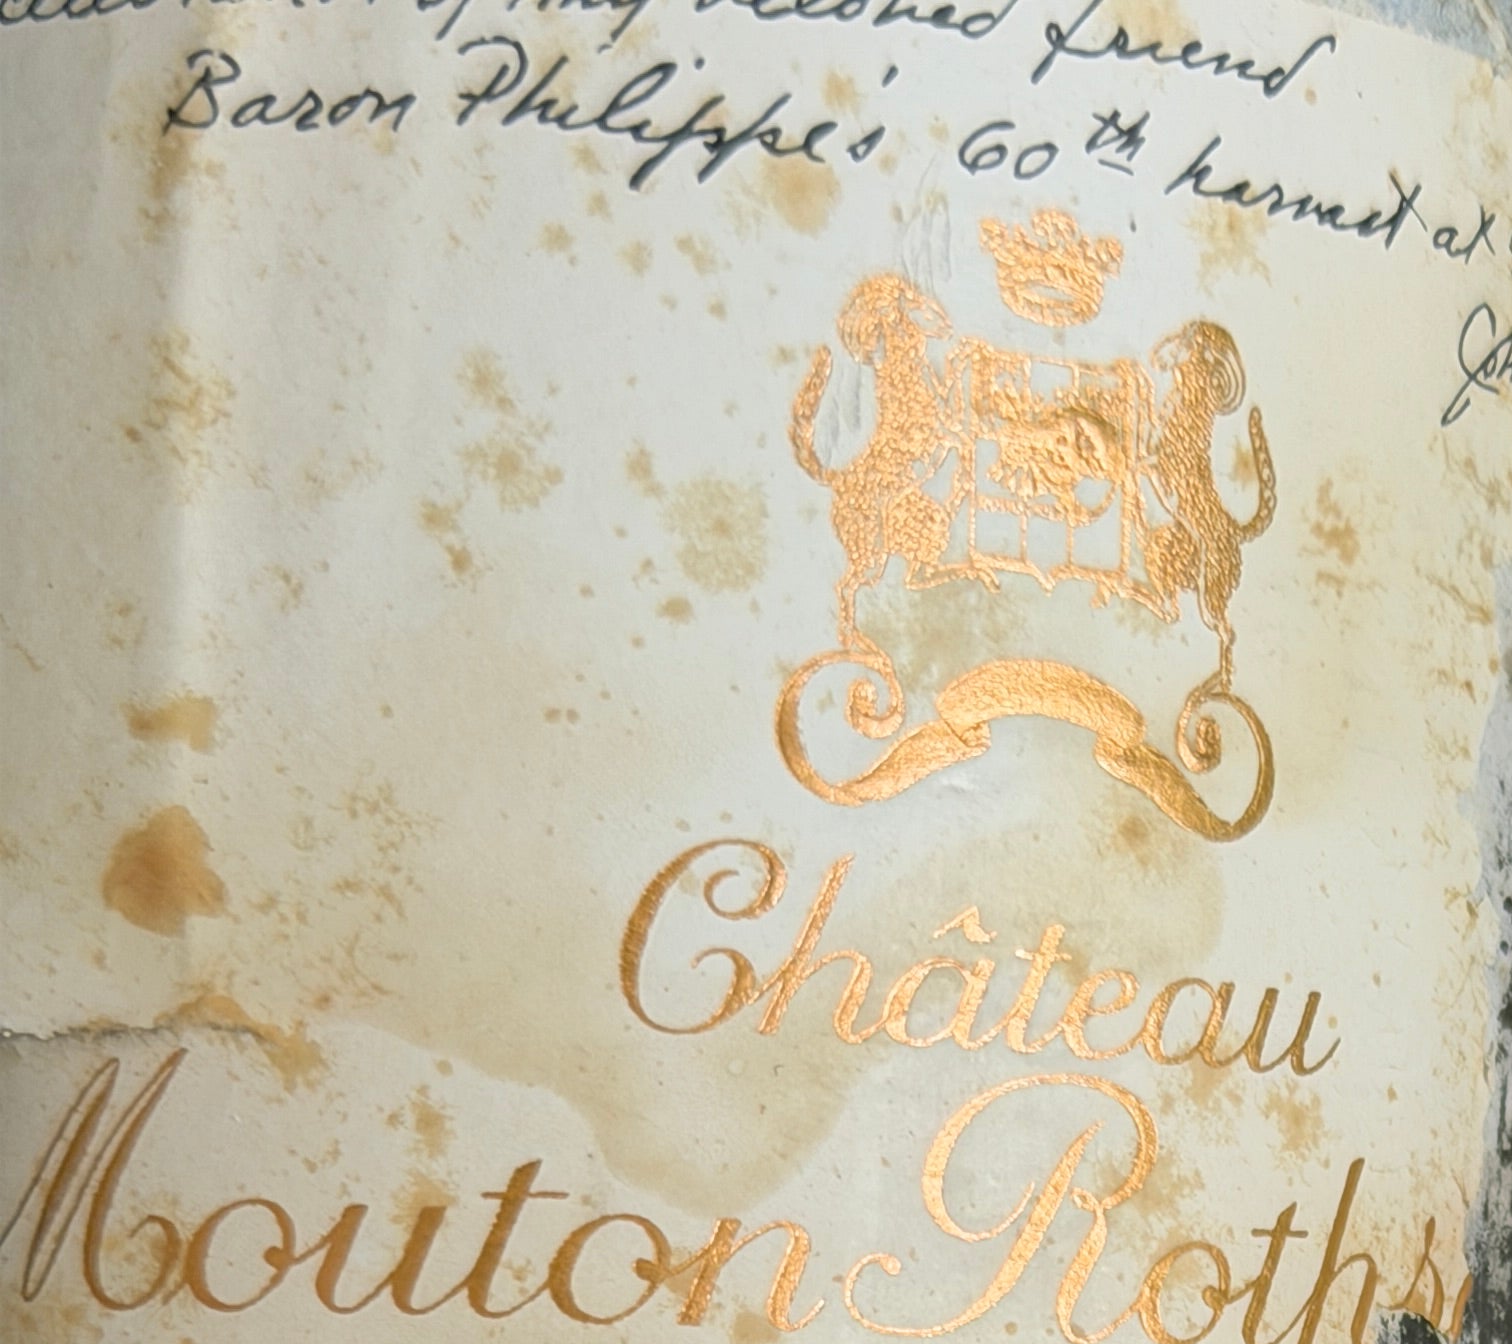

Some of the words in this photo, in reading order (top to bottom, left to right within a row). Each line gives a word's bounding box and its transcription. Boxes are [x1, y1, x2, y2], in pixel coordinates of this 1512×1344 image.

[162, 48, 417, 134] Baron
[1432, 205, 1497, 265] at
[619, 838, 1342, 1077] Château
[0, 1044, 826, 1333] Mouton
